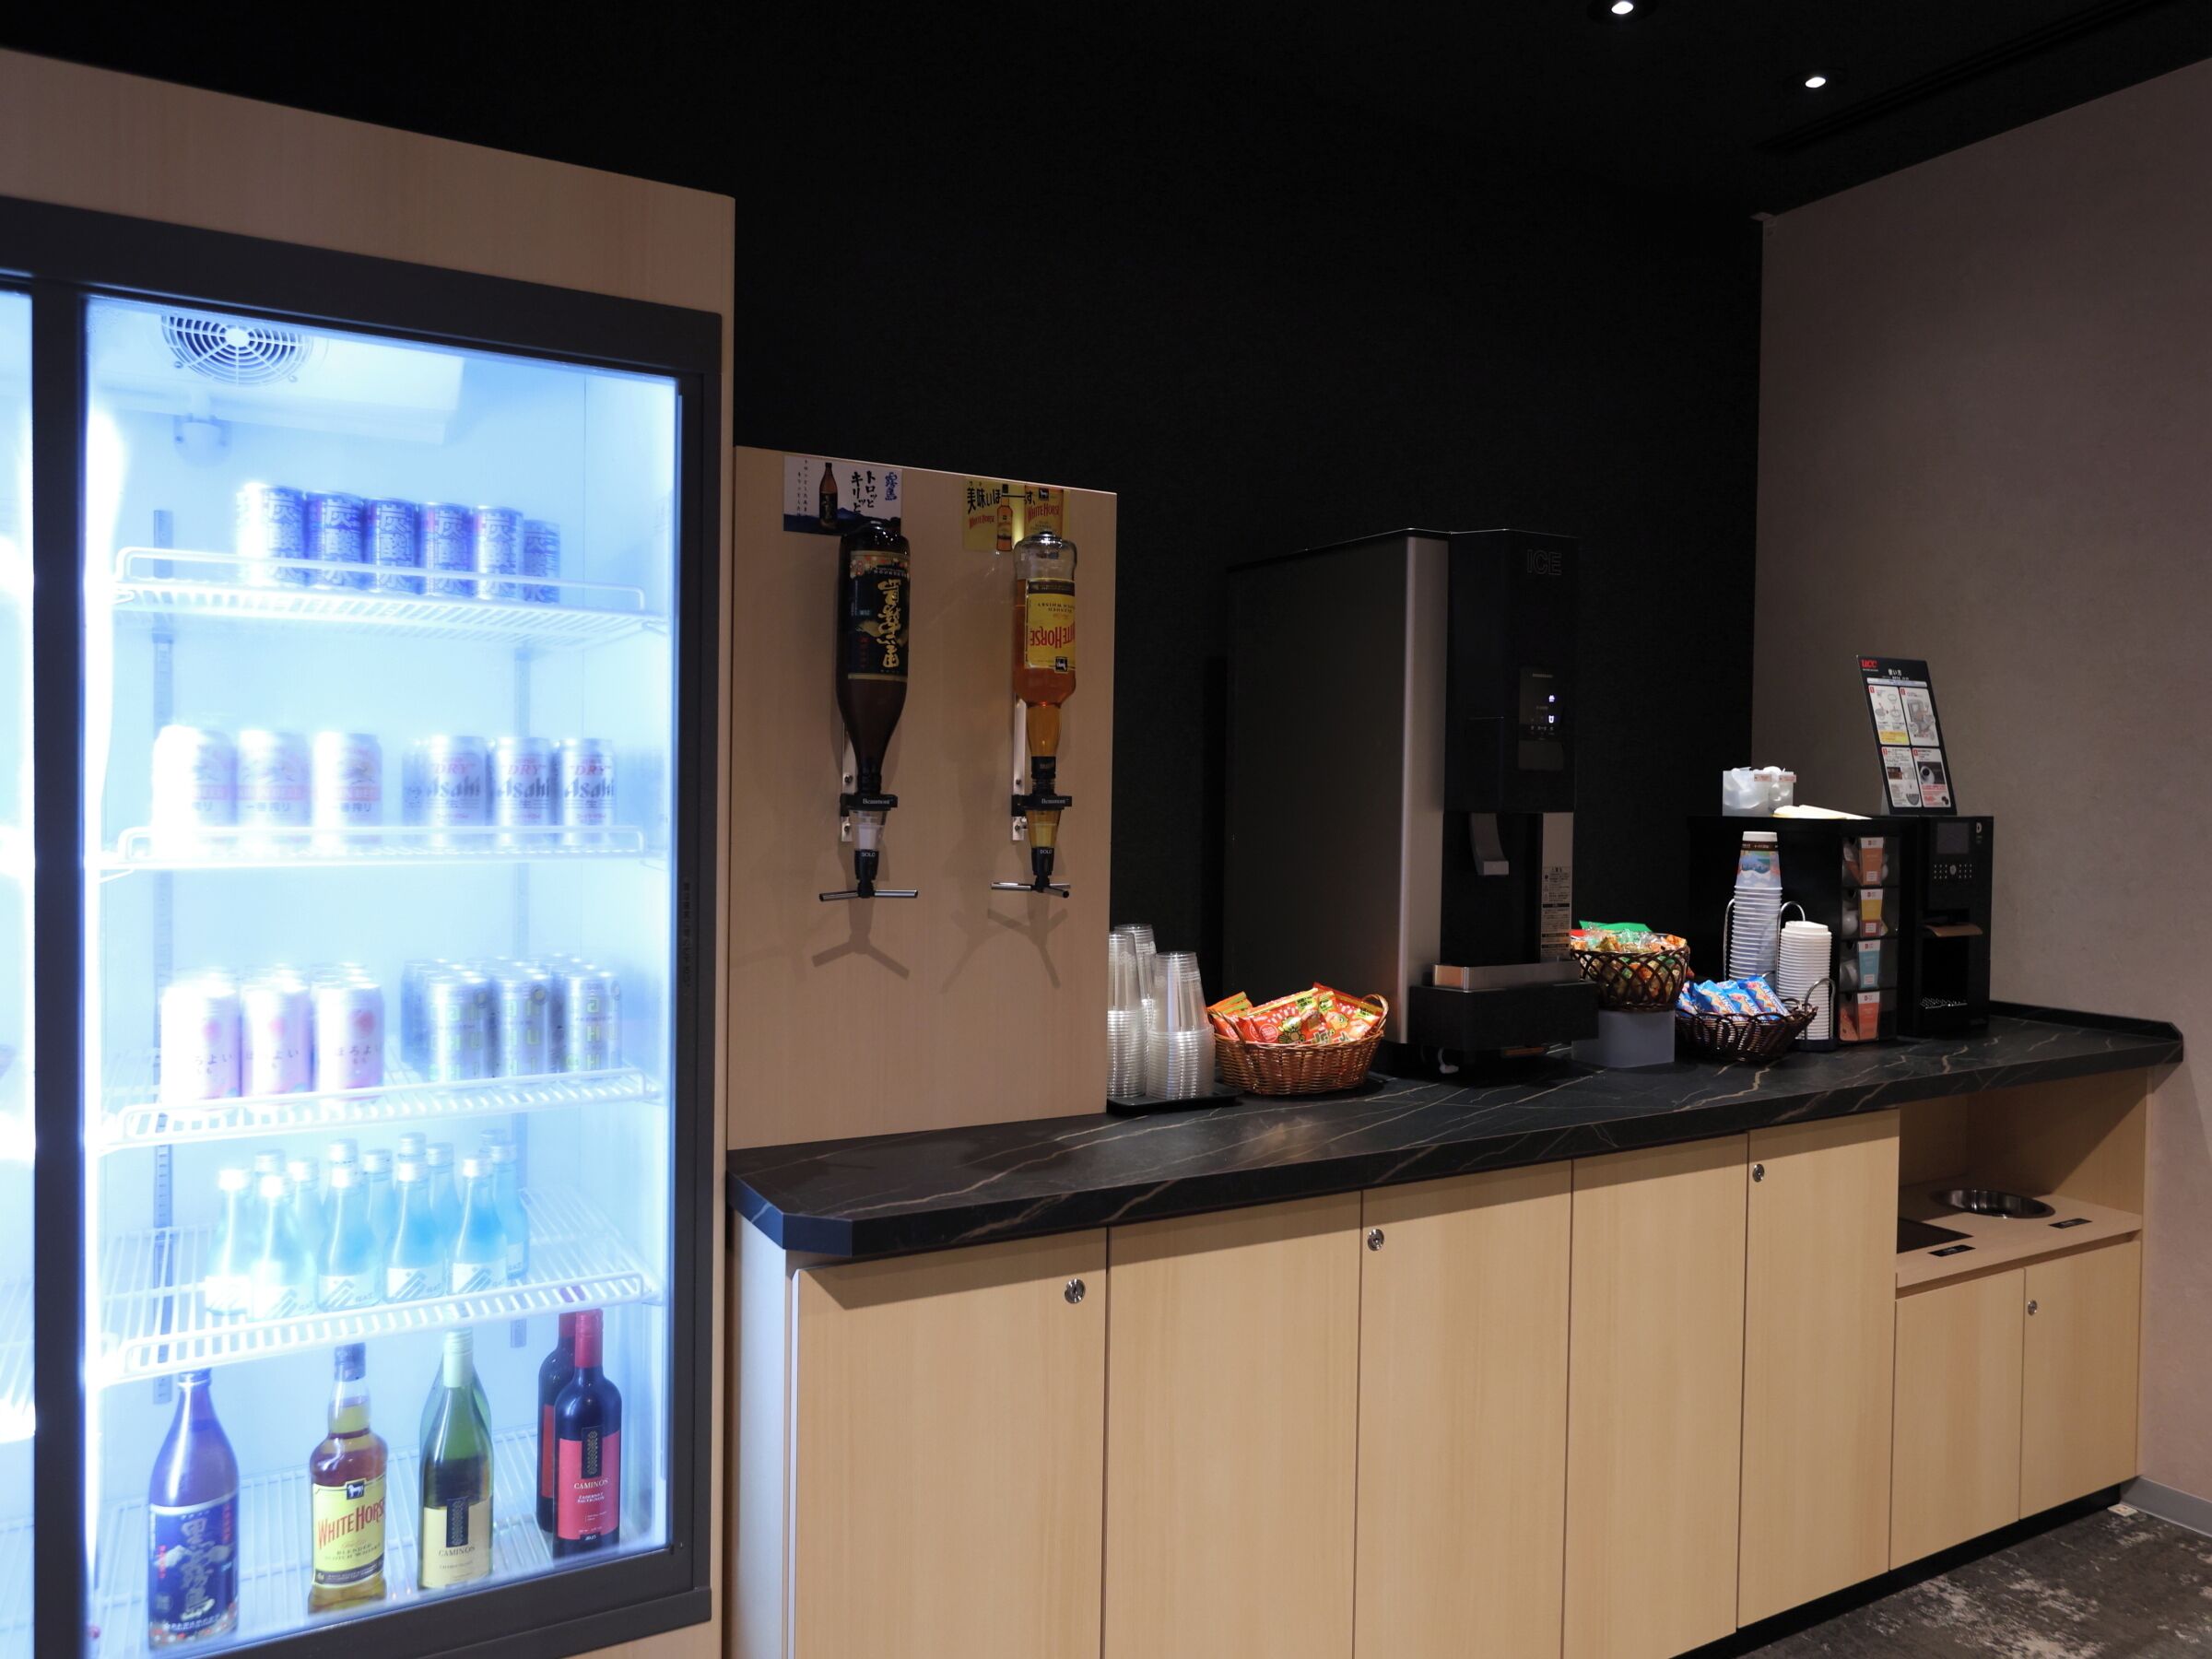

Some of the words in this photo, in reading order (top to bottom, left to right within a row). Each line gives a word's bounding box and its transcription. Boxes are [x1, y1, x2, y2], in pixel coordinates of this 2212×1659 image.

[852, 471, 866, 513] キリッと
[865, 470, 877, 508] トロッと
[885, 471, 898, 501] 霧島
[323, 499, 361, 584] 炭酸水
[379, 503, 412, 588] 炭酸水
[1526, 549, 1562, 575] ICE
[1030, 626, 1062, 649] HORSE
[427, 774, 481, 798] Asahi
[499, 776, 550, 798] Asahi
[564, 776, 615, 798] Asahi
[574, 1478, 609, 1489] CAMINOS
[317, 1513, 355, 1549] WHITE
[438, 1545, 476, 1557] CAMINOS
